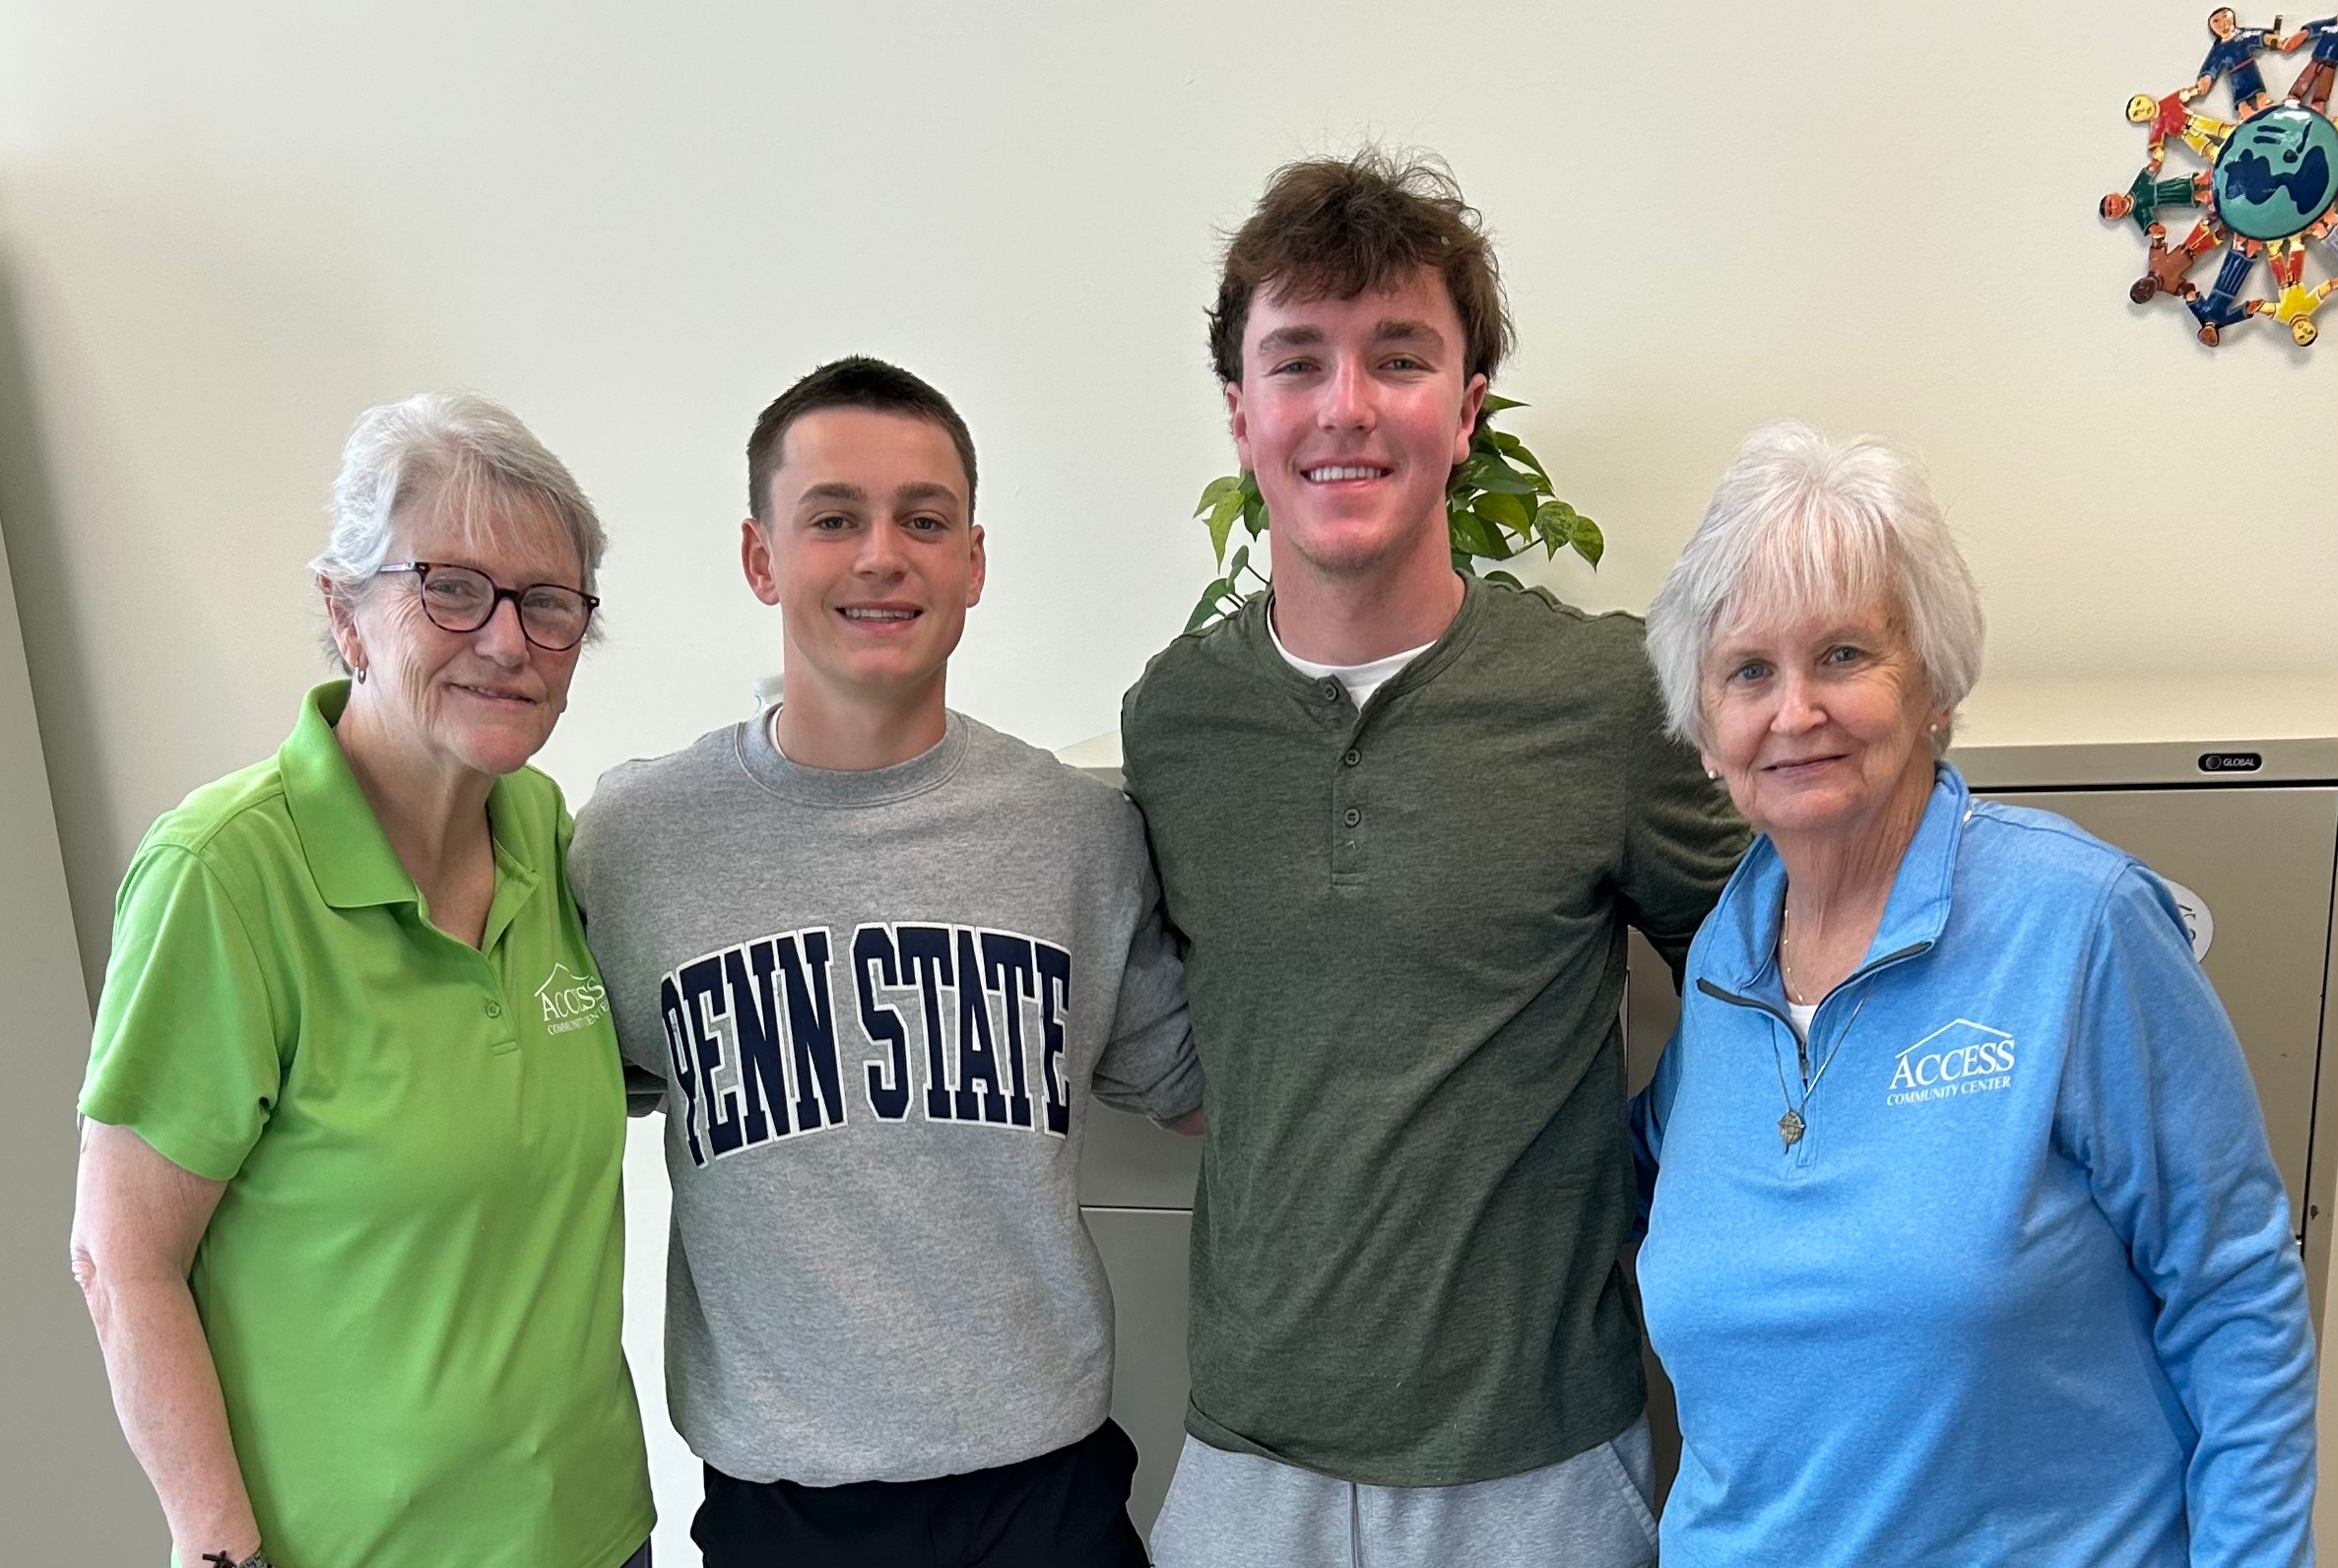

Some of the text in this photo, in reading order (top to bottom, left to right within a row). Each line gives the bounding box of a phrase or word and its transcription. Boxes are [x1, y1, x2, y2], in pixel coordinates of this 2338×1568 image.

[2223, 757, 2255, 767] GLOBAL
[584, 999, 611, 1026] ENTE
[661, 922, 1072, 1169] PENN STATE
[1889, 1039, 2016, 1090] ACCESS
[1886, 1075, 2011, 1107] COMMUNITY CENTER
